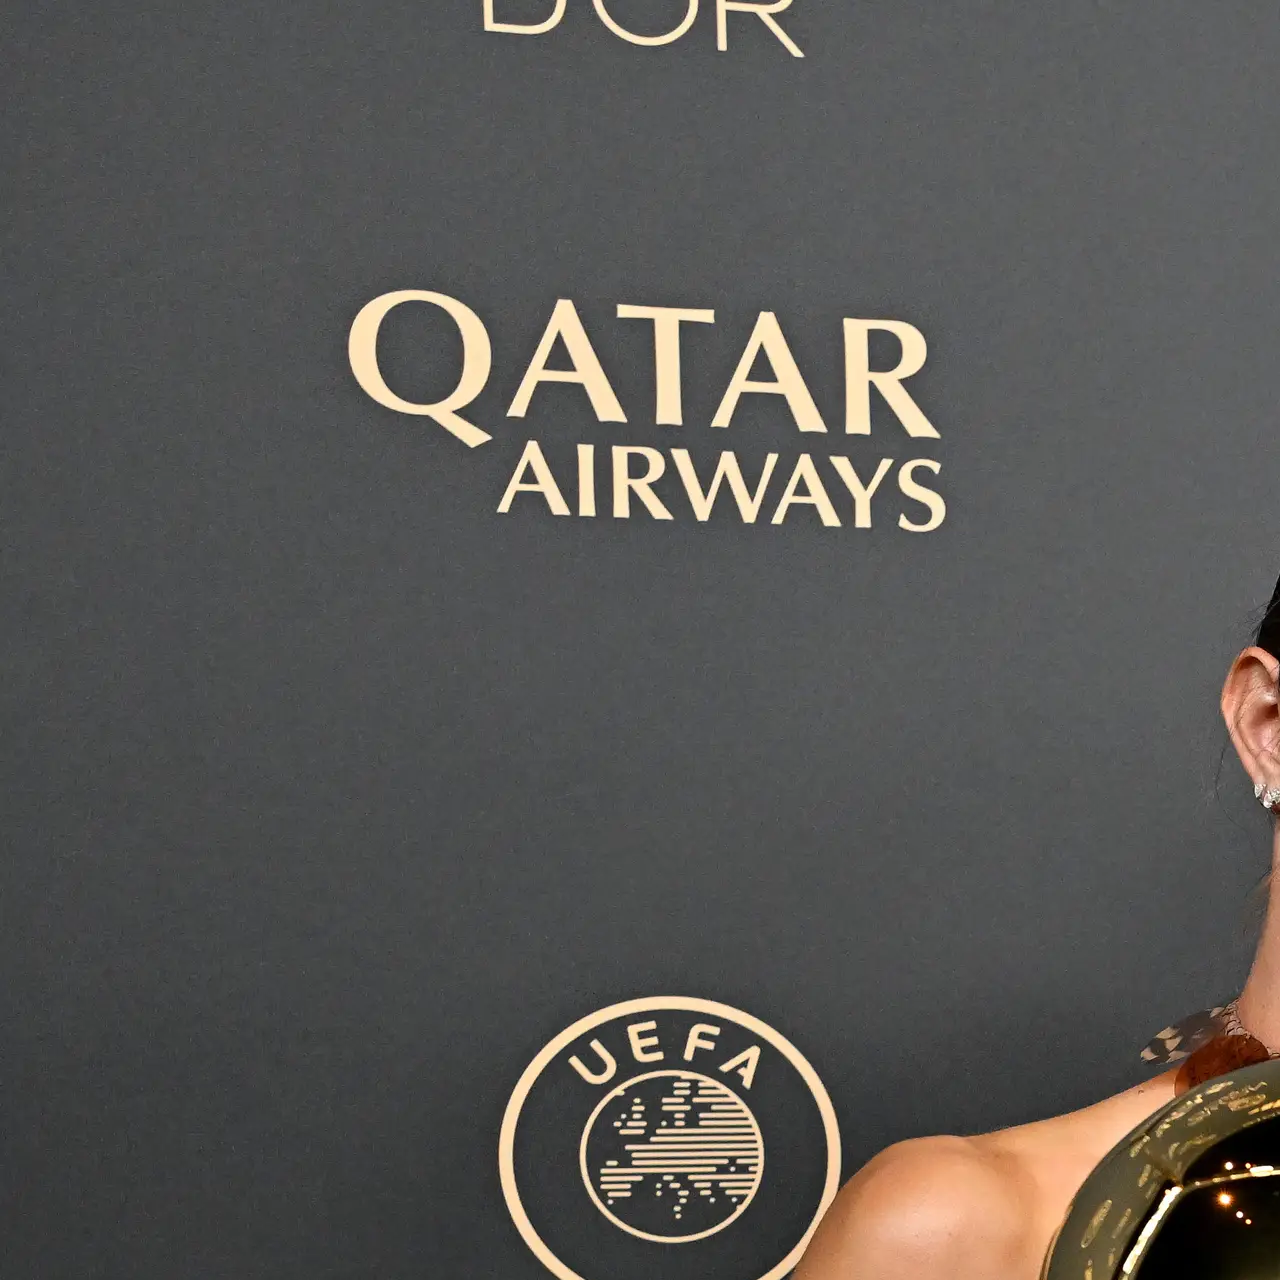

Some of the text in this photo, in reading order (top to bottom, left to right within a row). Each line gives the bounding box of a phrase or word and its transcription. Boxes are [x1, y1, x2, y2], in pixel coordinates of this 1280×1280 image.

[349, 290, 941, 448] QATAR
[497, 440, 946, 533] AIRWAYS
[568, 1020, 761, 1090] UEFA
